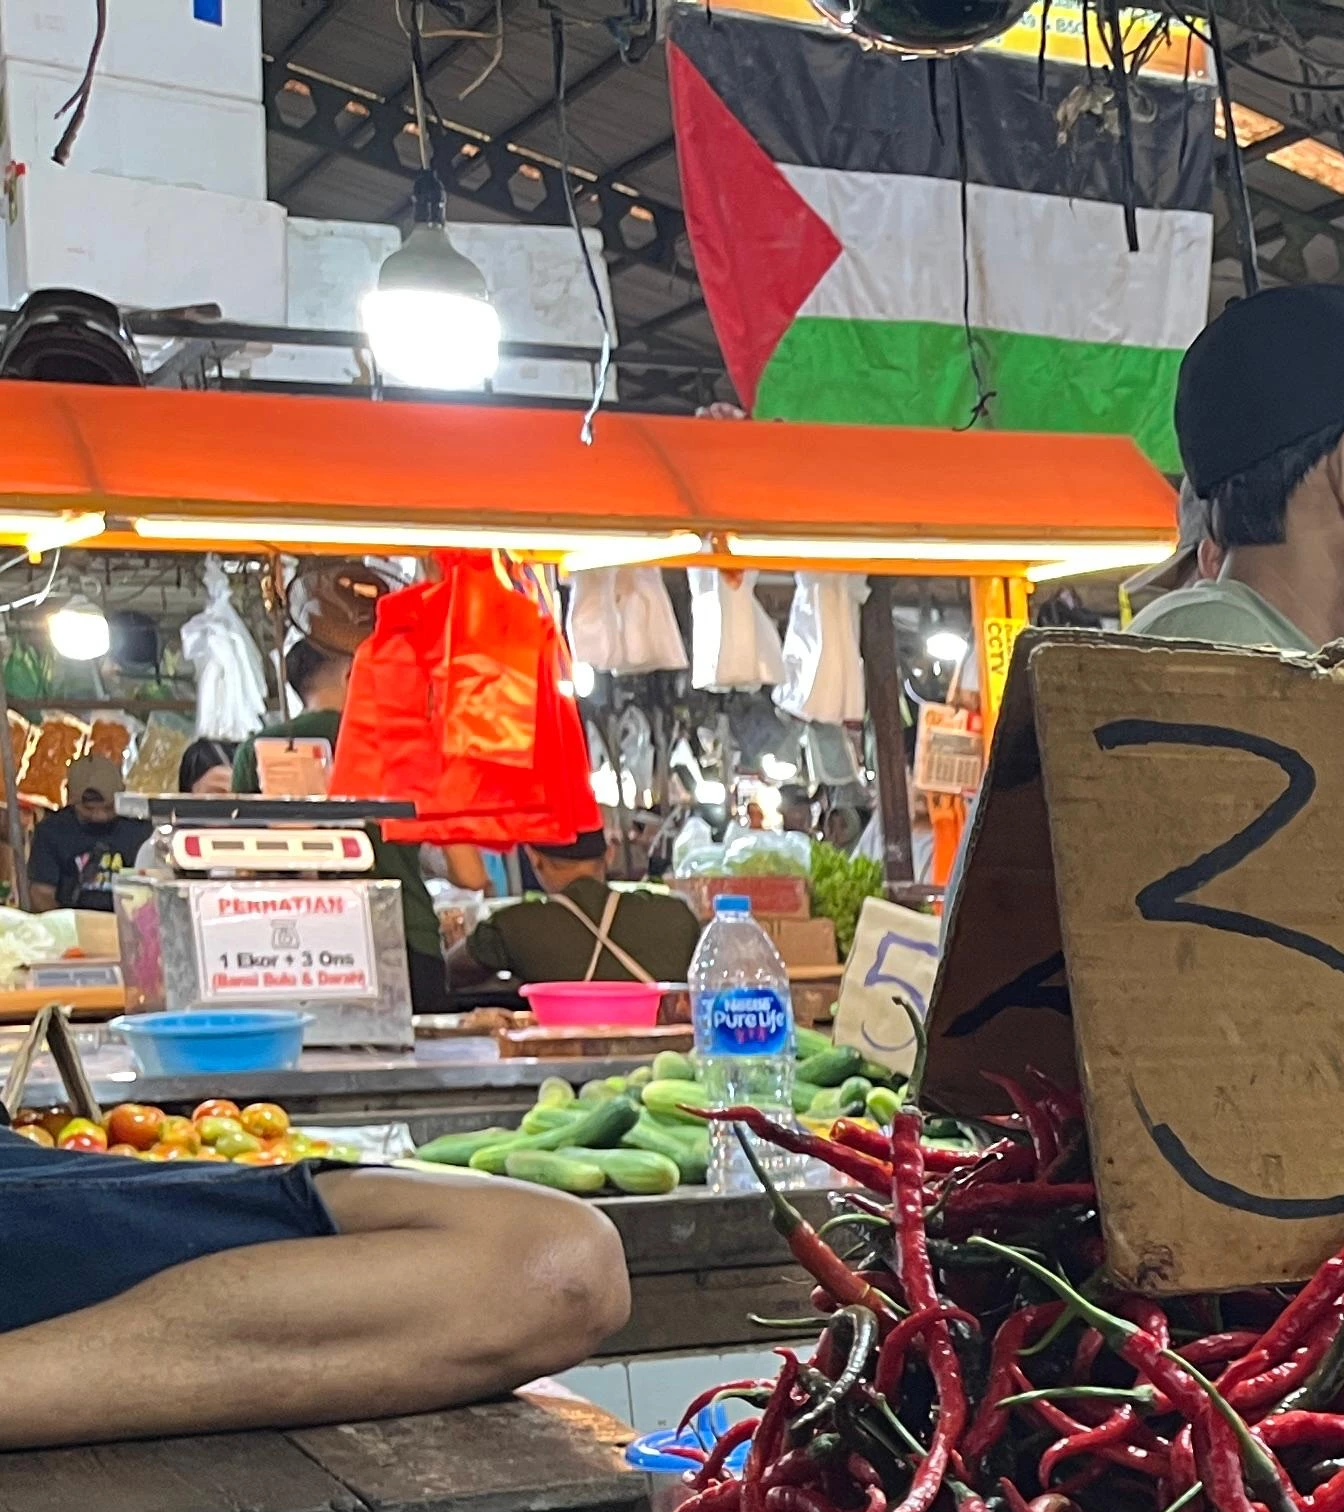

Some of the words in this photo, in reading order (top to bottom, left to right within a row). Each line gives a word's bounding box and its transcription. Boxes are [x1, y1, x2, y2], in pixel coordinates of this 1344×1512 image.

[987, 622, 1004, 676] CCTV
[219, 895, 345, 916] PERHATIAN
[237, 952, 279, 968] Ekor
[302, 951, 313, 968] 3
[714, 1010, 758, 1030] Pure
